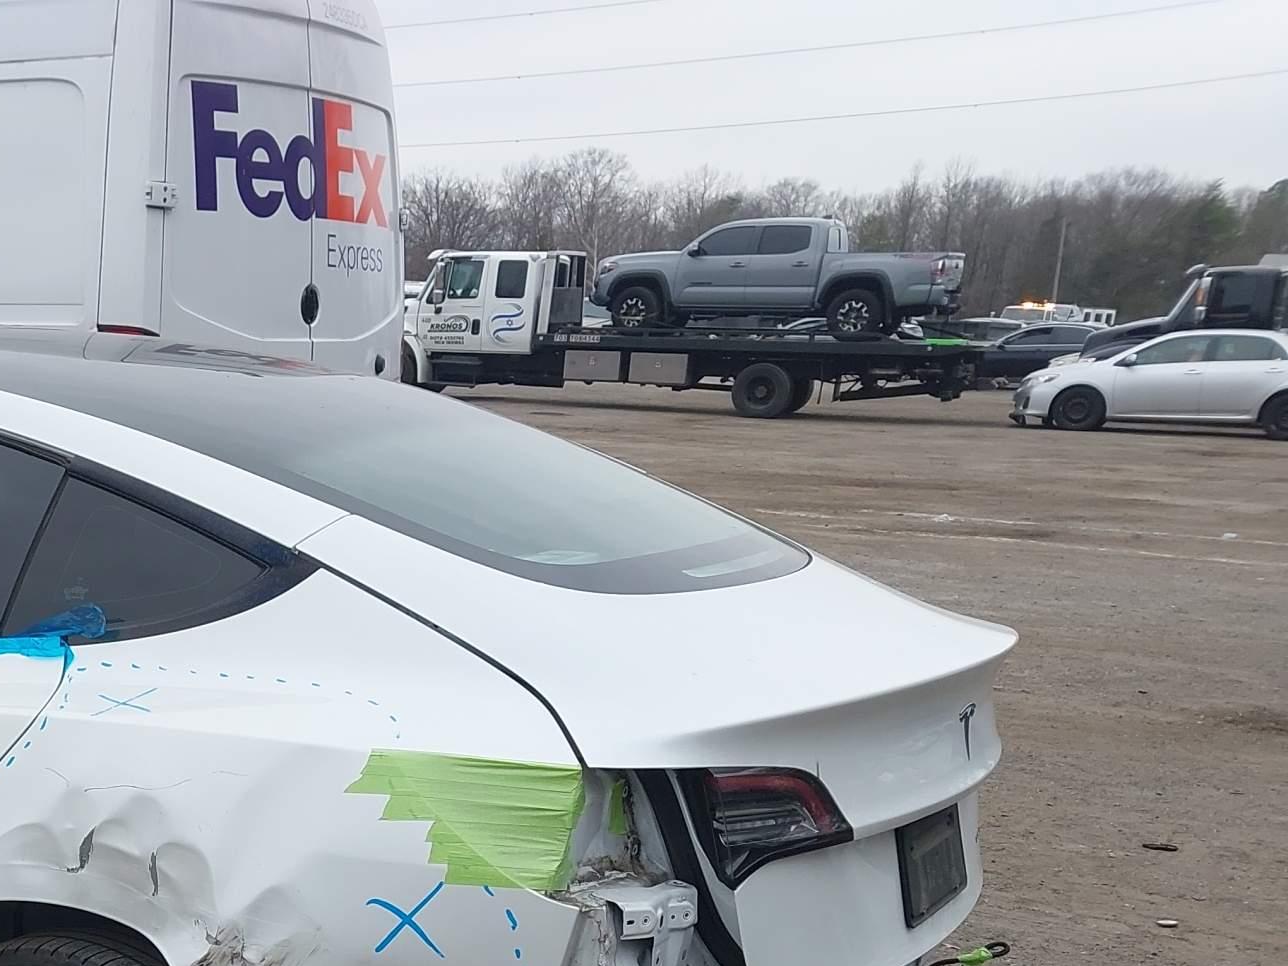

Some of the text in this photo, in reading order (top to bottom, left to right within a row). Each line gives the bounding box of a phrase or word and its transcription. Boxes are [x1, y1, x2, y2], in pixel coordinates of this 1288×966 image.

[191, 80, 388, 228] FedEx
[327, 233, 383, 278] Express
[430, 322, 463, 330] KRONOS
